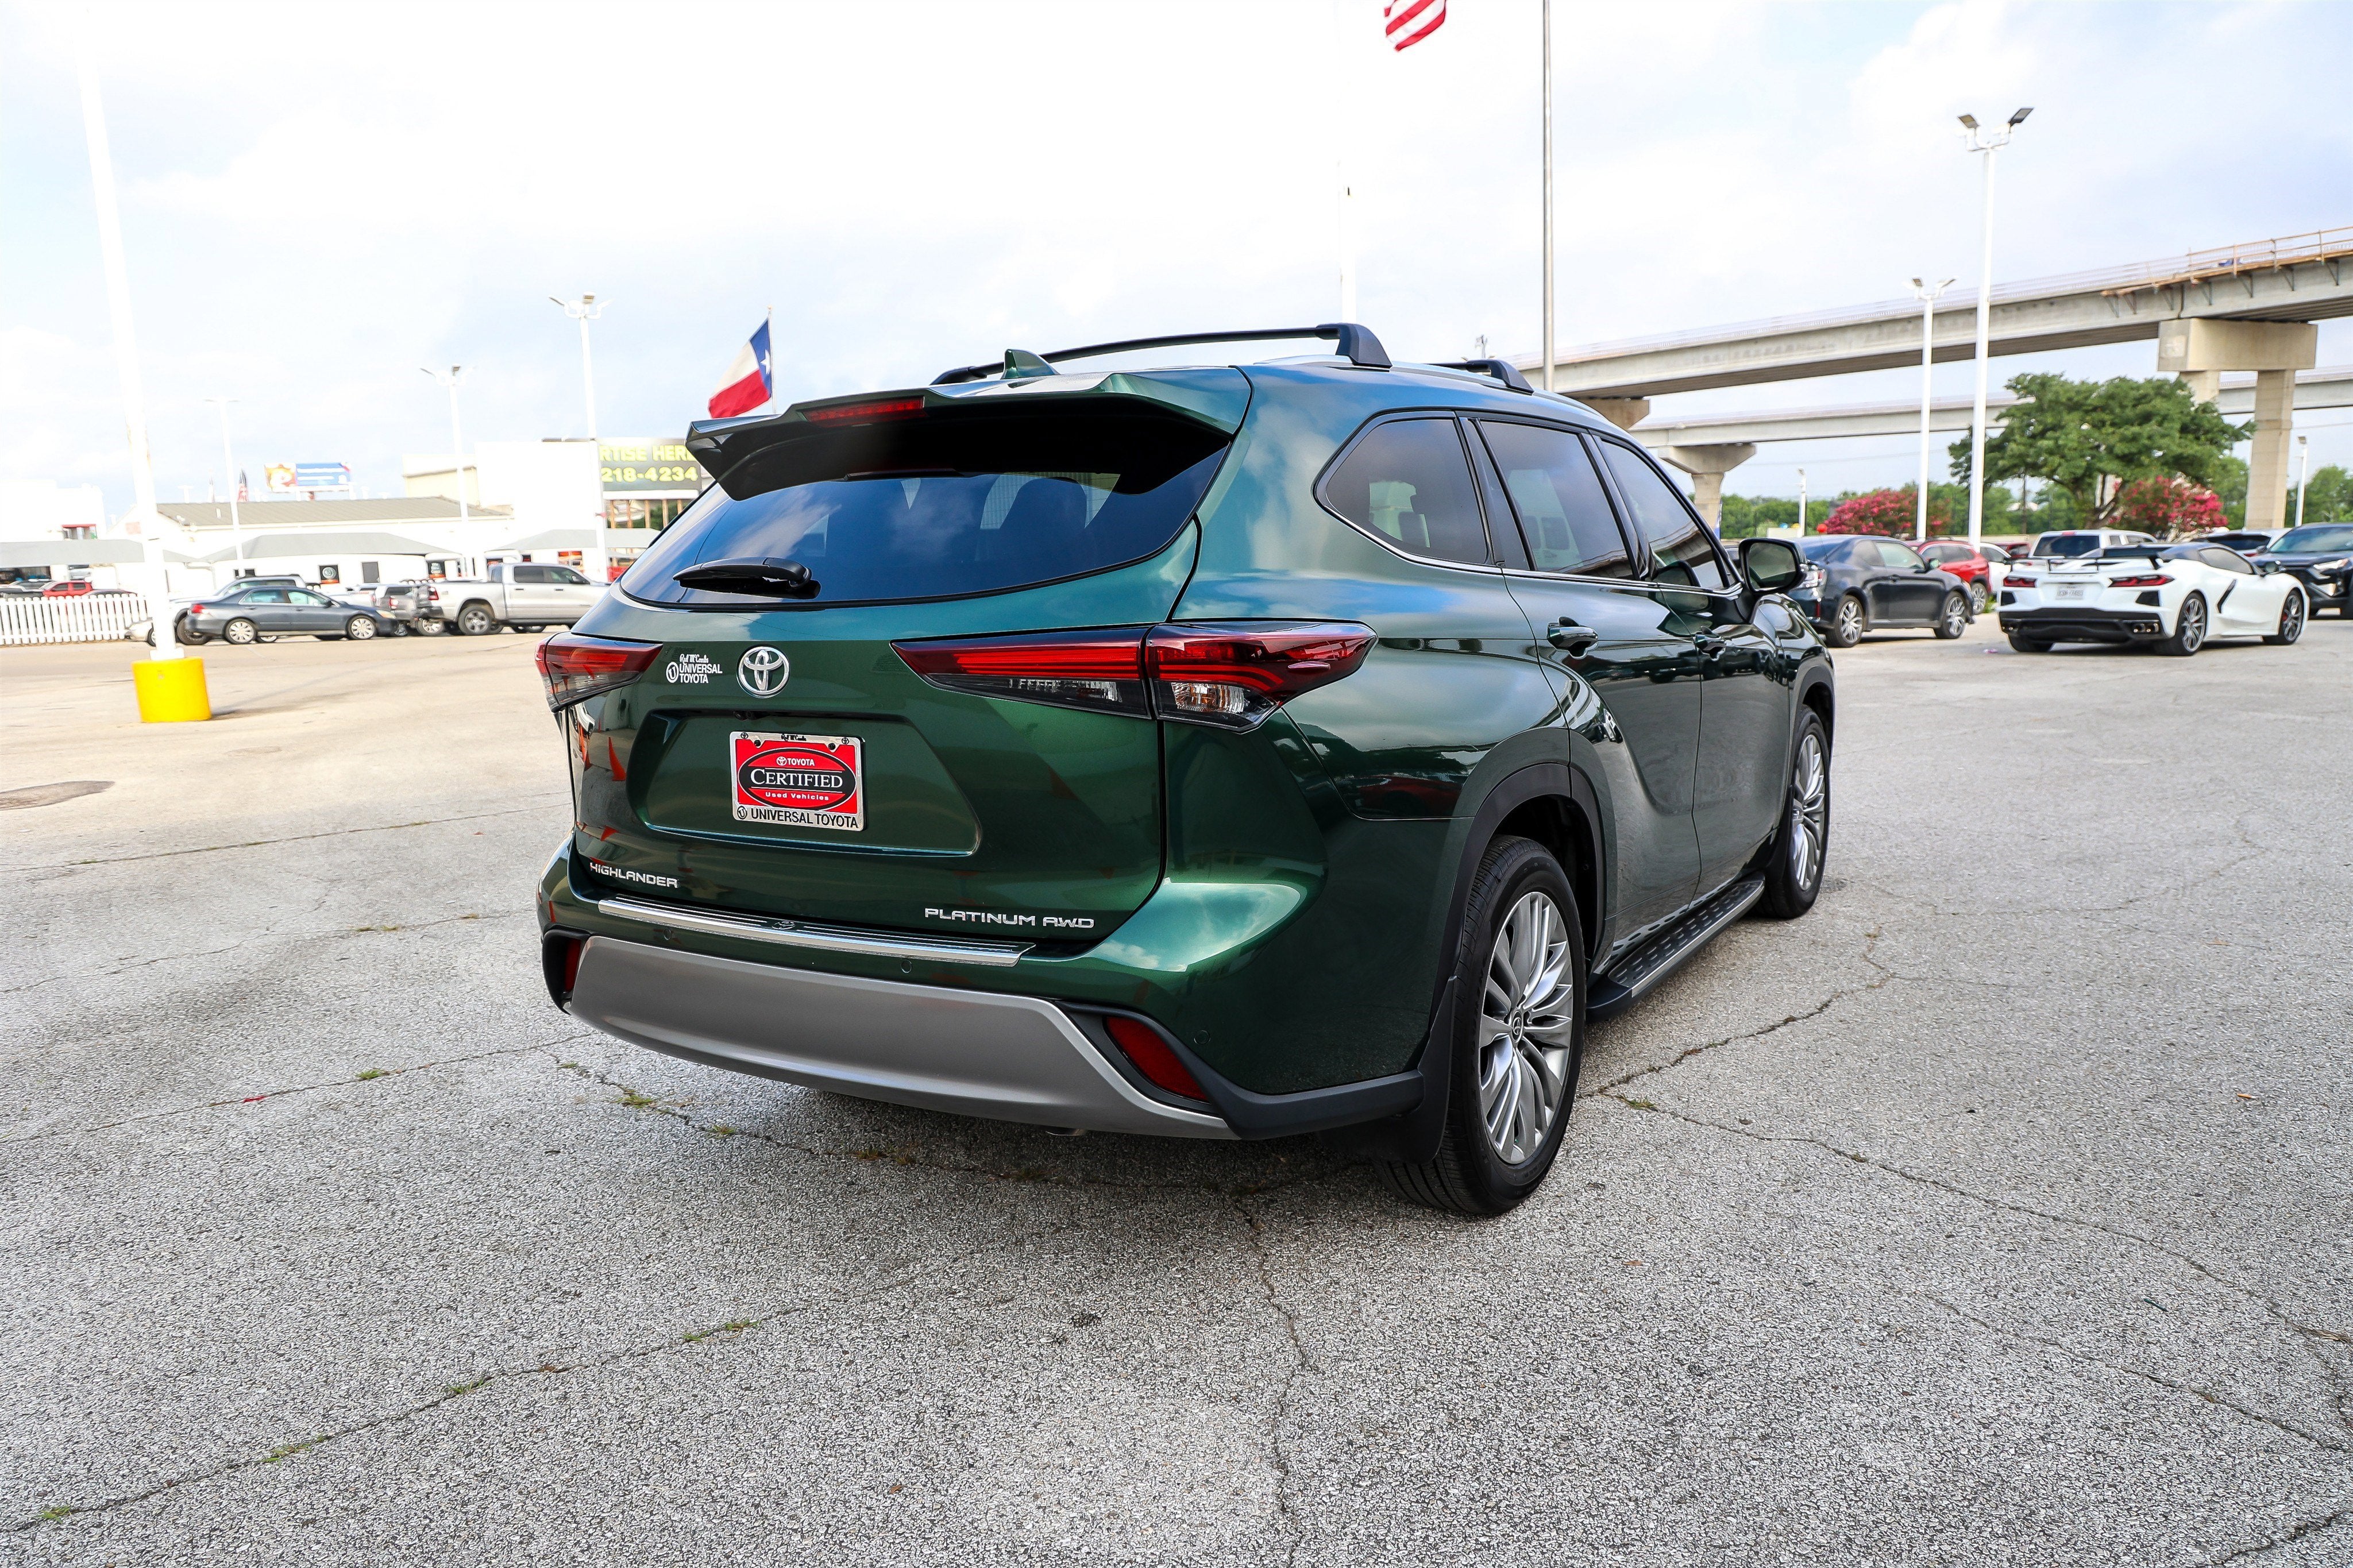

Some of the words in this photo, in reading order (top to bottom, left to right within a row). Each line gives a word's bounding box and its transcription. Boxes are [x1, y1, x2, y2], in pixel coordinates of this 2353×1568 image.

[601, 466, 698, 482] 218-4234
[680, 654, 688, 665] Red
[680, 663, 723, 674] UNIVERSAL
[679, 673, 709, 683] TOYOTA
[787, 758, 815, 766] TOYOTA
[750, 769, 843, 789] CERTIFIED
[751, 808, 813, 824] UNIVERSAL
[814, 813, 859, 828] TOYOTA
[589, 862, 678, 889] HIGHLANDER
[925, 907, 1036, 926] PLATINUM
[1043, 917, 1094, 928] AWD
